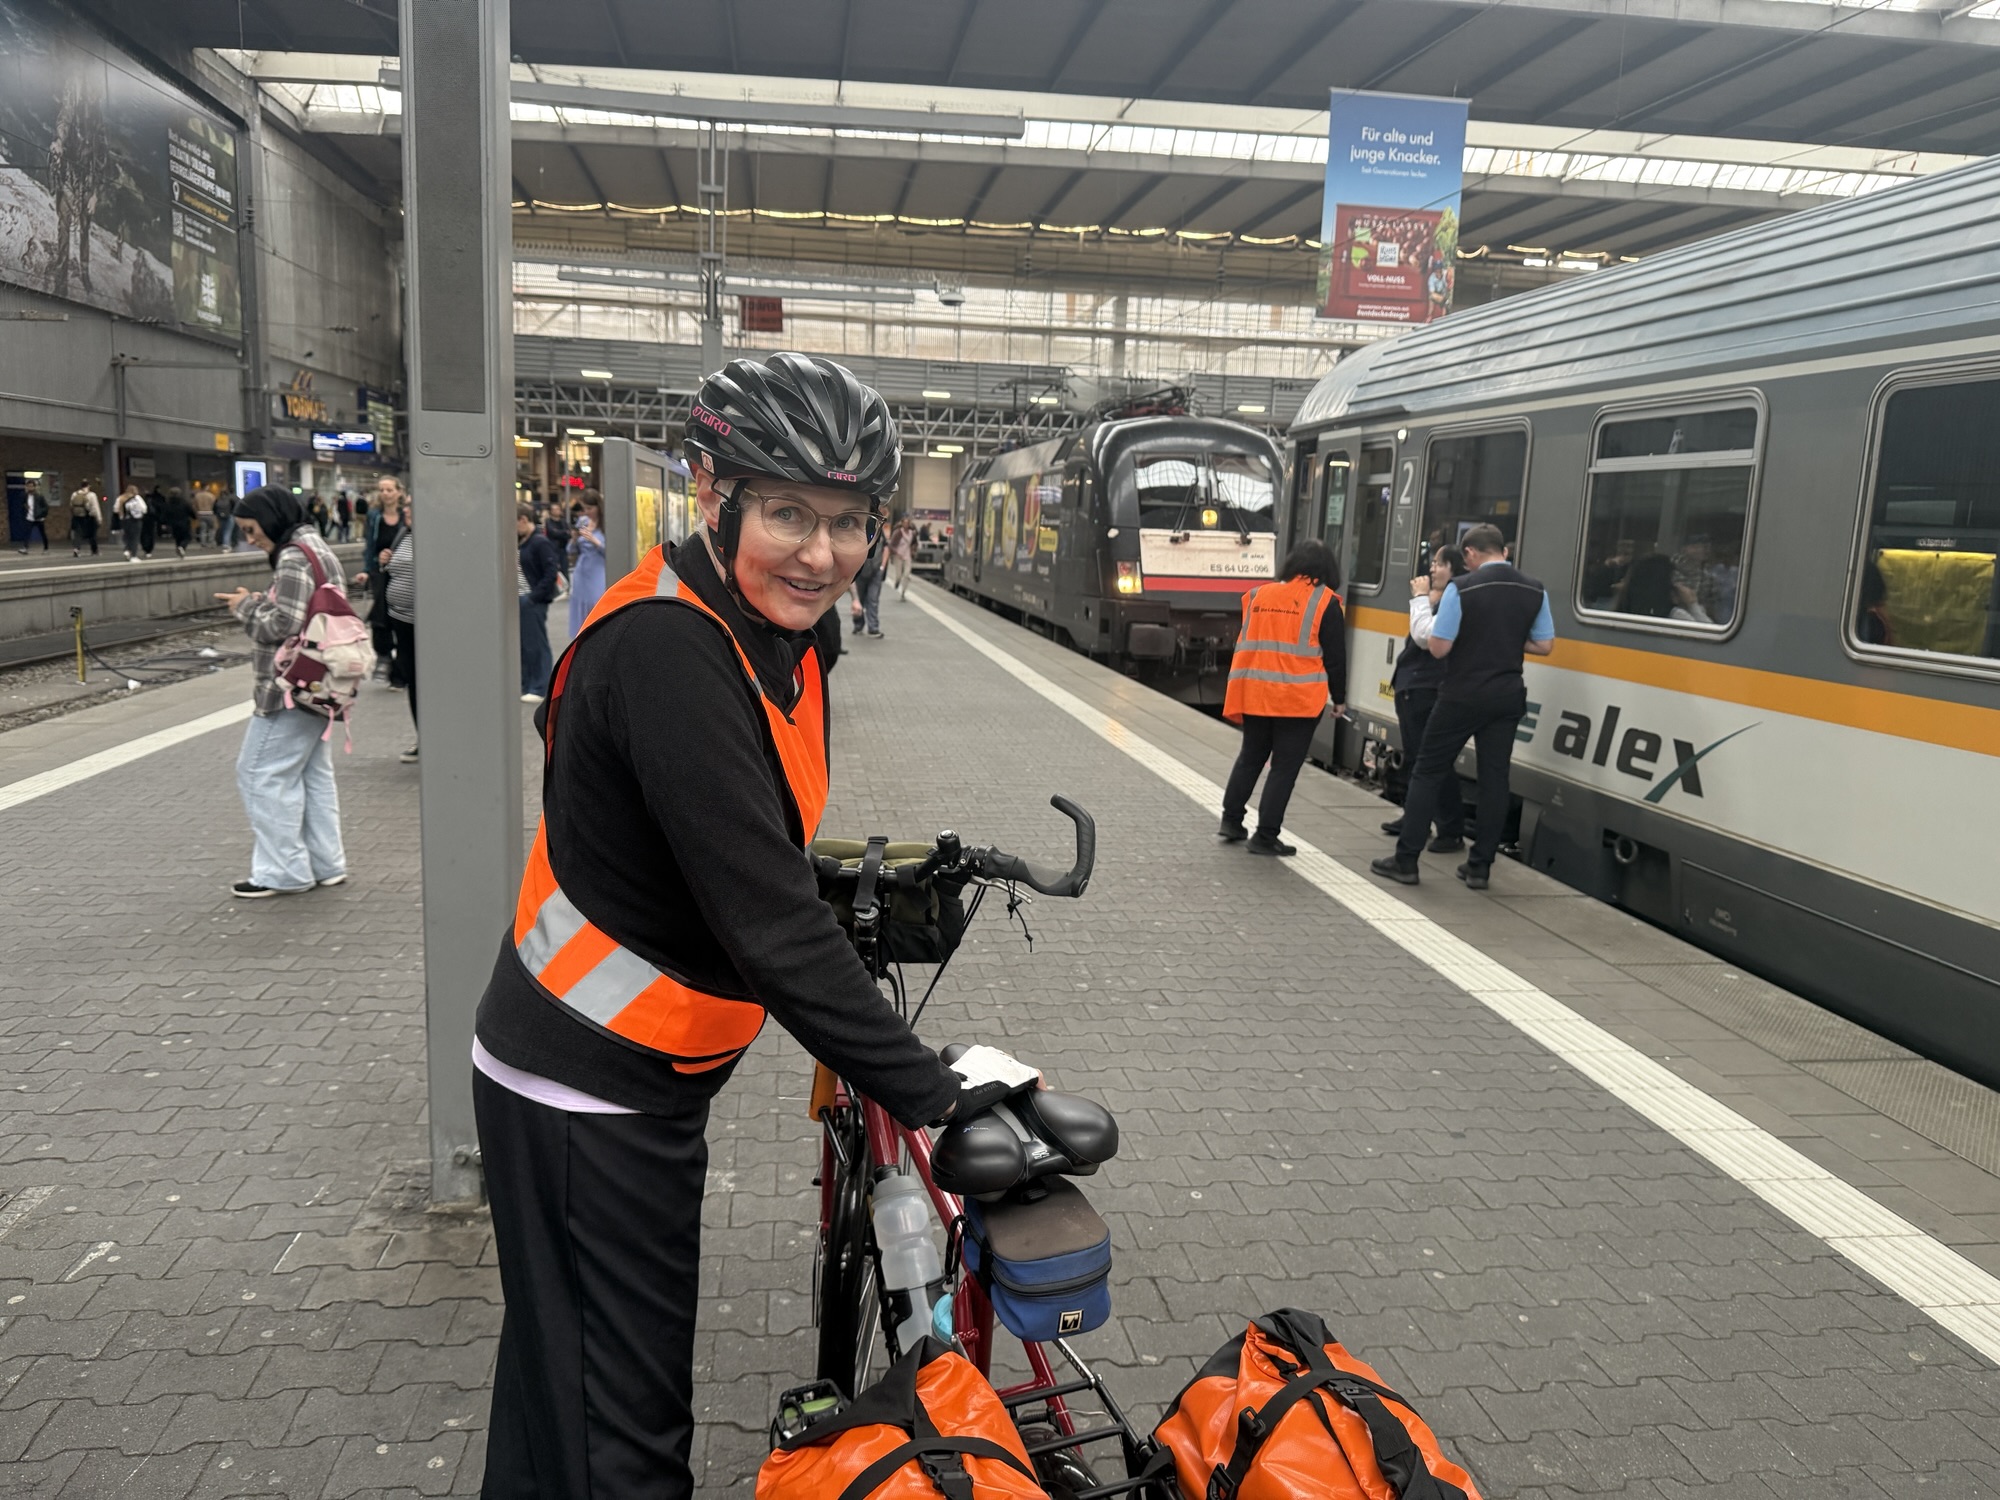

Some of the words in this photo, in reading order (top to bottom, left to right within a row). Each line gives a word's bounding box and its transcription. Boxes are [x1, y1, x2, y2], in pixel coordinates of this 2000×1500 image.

[1362, 126, 1381, 142] Für
[1383, 127, 1407, 144] alte
[1409, 130, 1434, 146] und
[1350, 144, 1386, 164] junge
[1388, 146, 1441, 165] Knacker.
[700, 411, 732, 437] GIRO
[827, 470, 857, 483] GIRO
[1399, 461, 1414, 504] 2
[1210, 563, 1222, 572] ES
[1224, 564, 1236, 573] 64
[1552, 704, 1763, 804] alex
